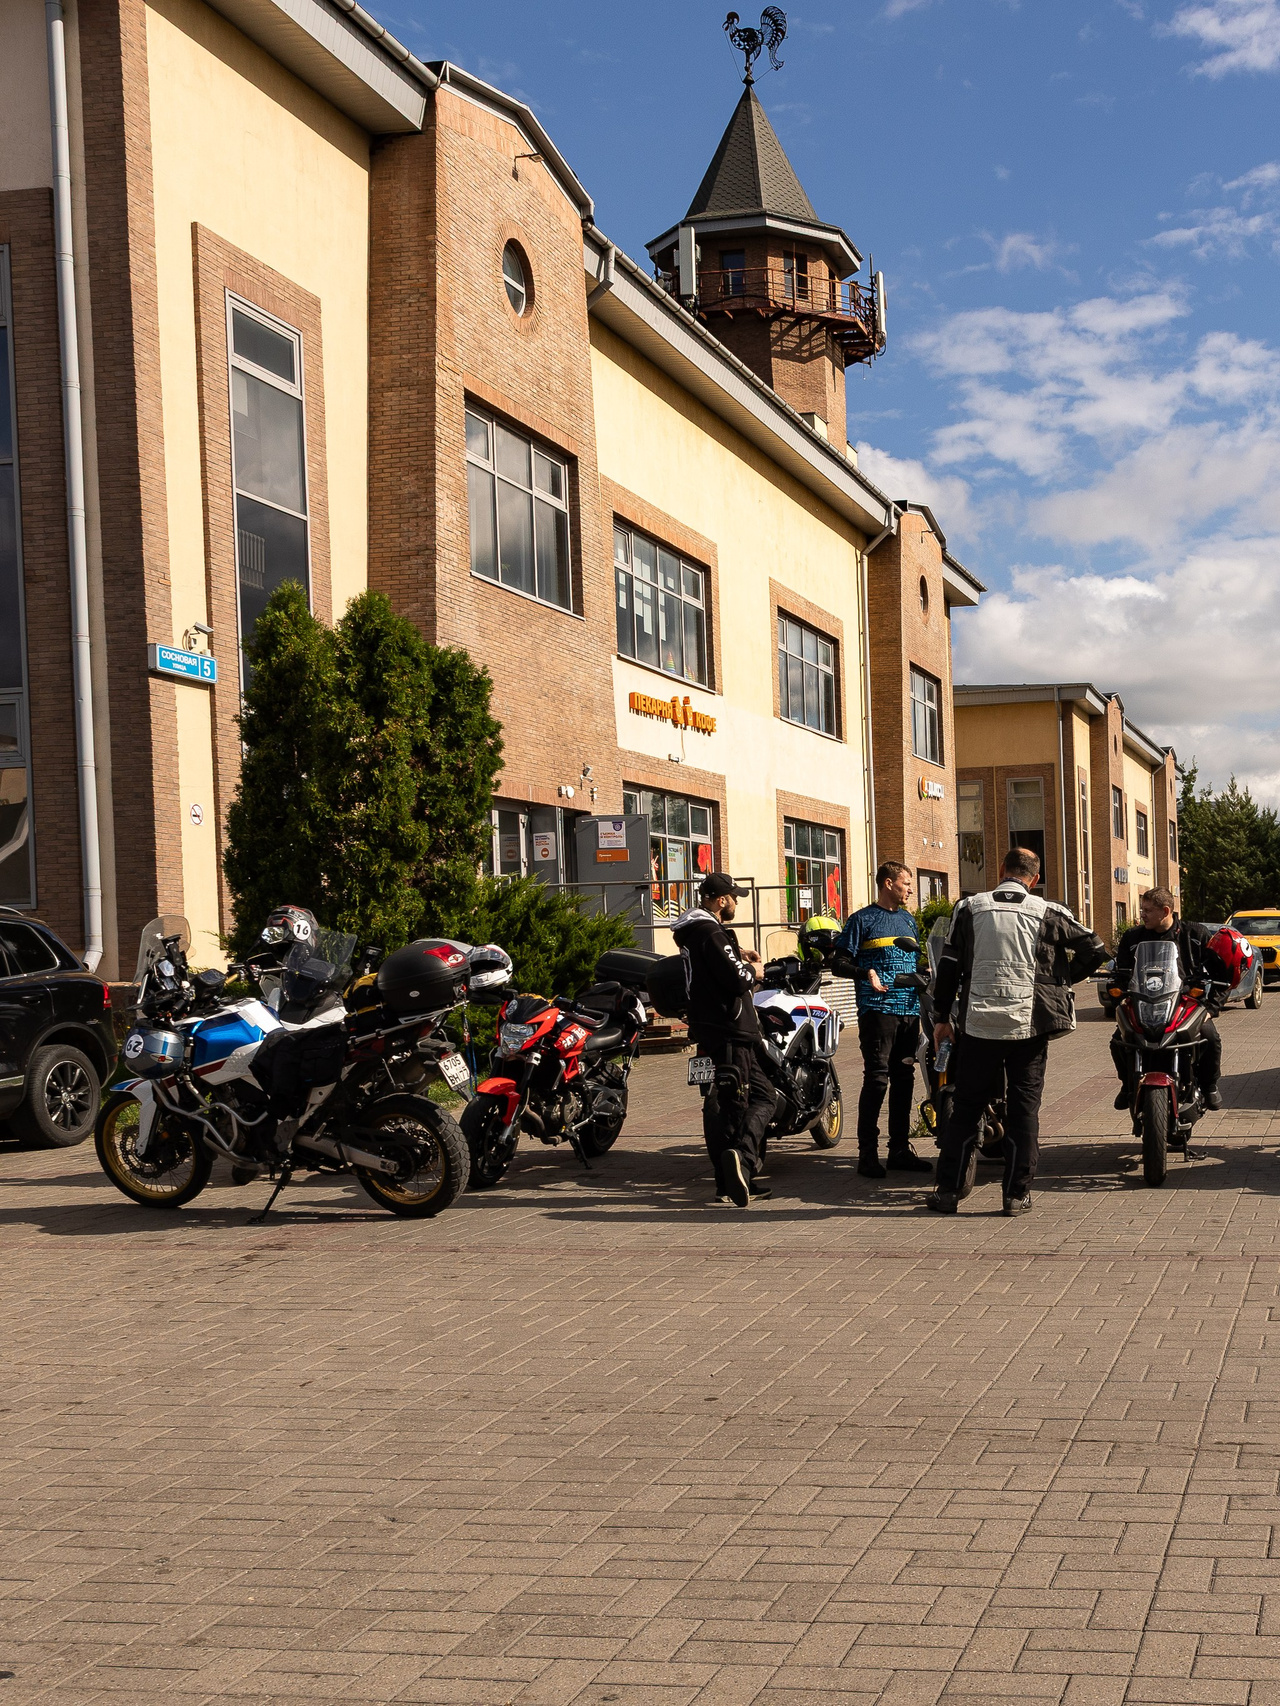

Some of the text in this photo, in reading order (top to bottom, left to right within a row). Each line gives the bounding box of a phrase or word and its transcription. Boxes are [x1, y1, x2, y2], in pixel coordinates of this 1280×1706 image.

[161, 650, 198, 666] СОСНОВАЯ
[203, 661, 211, 677] 5
[631, 692, 716, 732] ПЕКАРНЯ КОФЕ
[296, 924, 309, 935] 16
[443, 1056, 462, 1071] 6705
